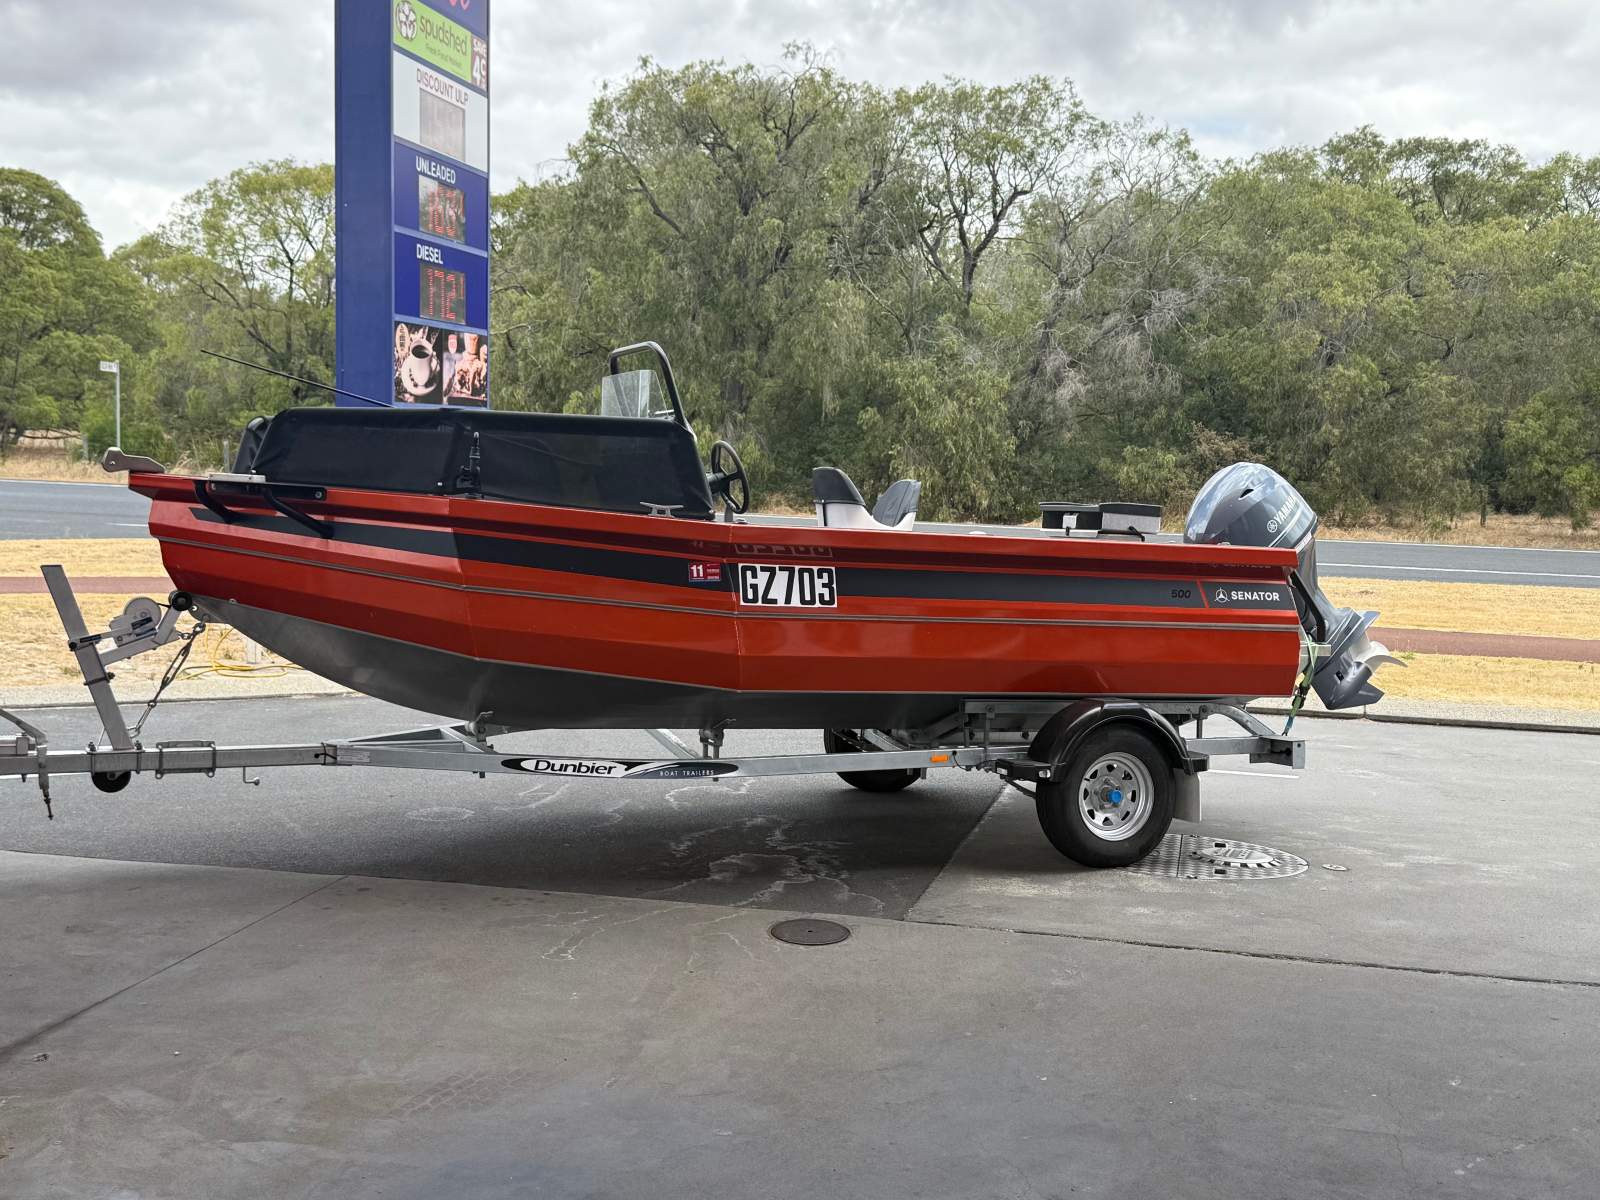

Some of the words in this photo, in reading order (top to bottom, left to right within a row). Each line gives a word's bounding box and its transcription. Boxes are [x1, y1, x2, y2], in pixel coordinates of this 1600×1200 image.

[419, 15, 467, 56] spudshed
[416, 68, 454, 99] DISCOUNT
[455, 90, 469, 106] ULP
[416, 155, 456, 185] UNLEADED
[416, 243, 443, 265] DIESEL
[690, 564, 704, 578] 11
[740, 565, 836, 606] GZ703
[1171, 589, 1191, 599] 500
[1231, 590, 1280, 601] SENATOR
[534, 759, 617, 775] Dunbier
